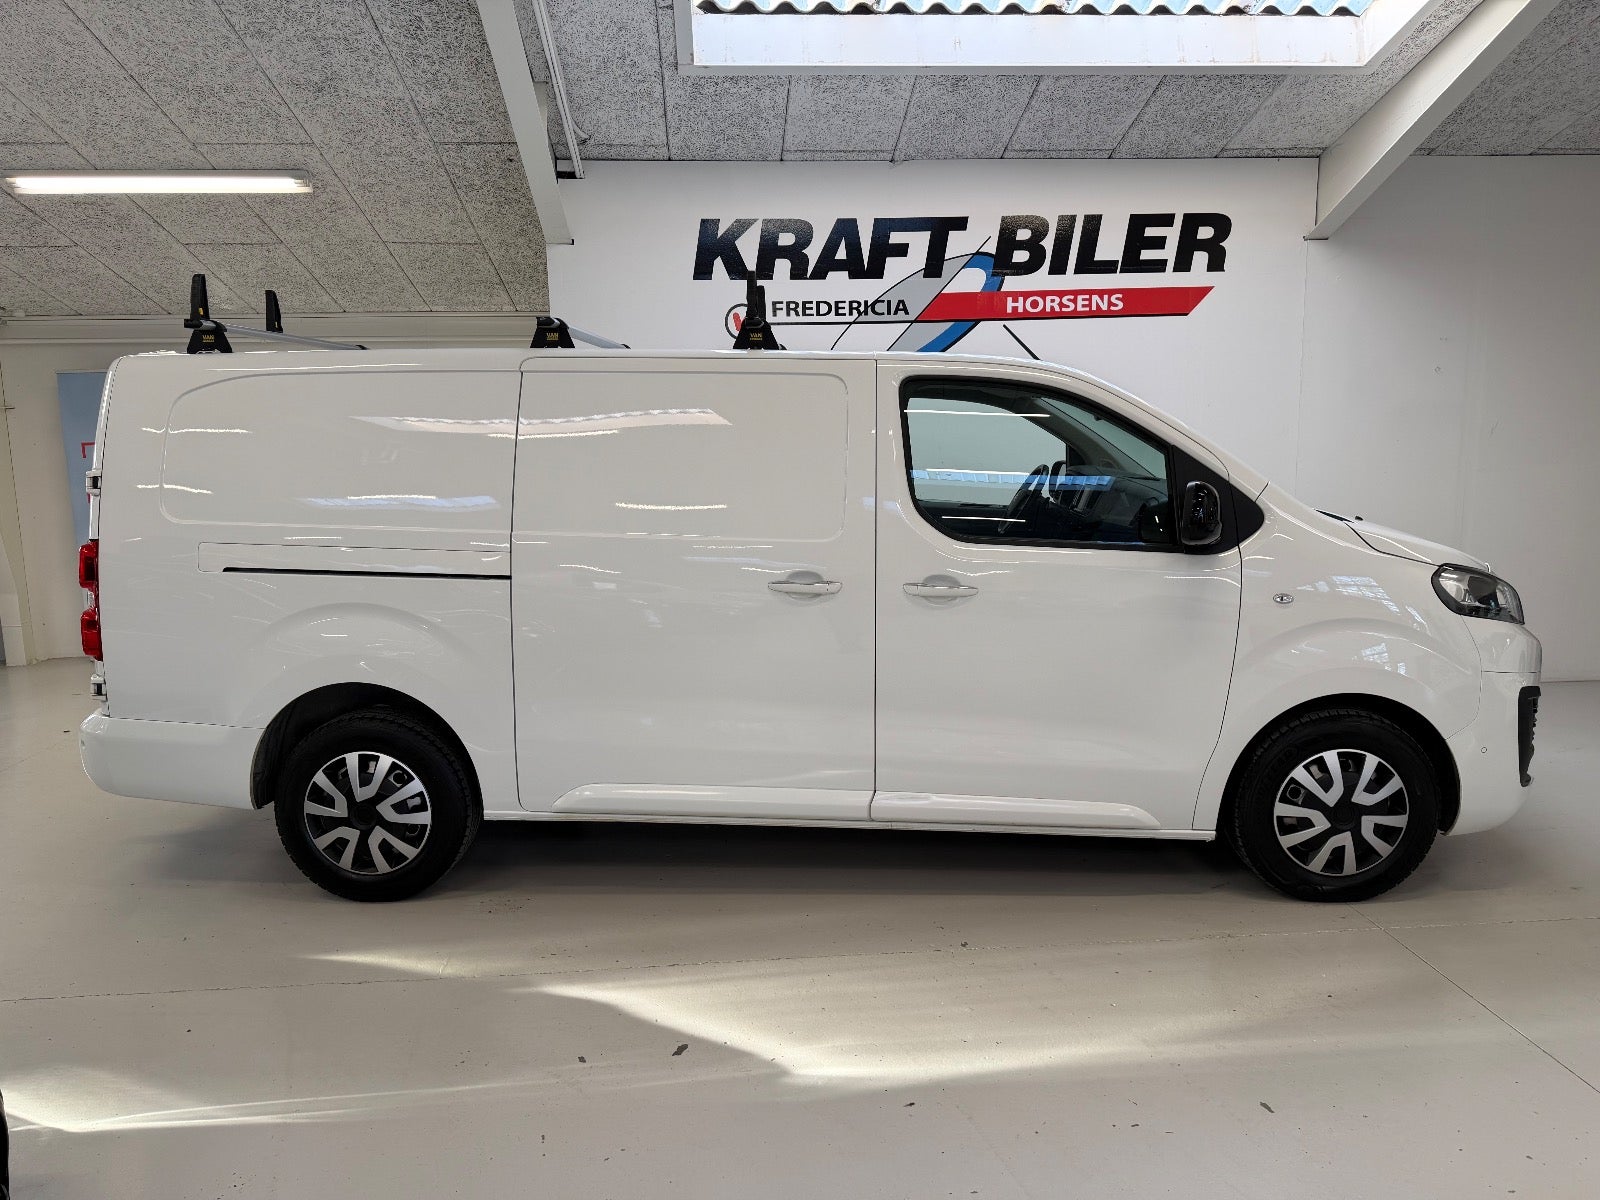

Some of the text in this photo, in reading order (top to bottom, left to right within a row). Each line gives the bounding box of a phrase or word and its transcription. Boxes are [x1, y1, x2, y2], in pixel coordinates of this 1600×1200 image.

[693, 213, 1232, 280] KRAFT BILER
[771, 299, 910, 317] FREDERICIA
[1006, 293, 1124, 313] HORSENS
